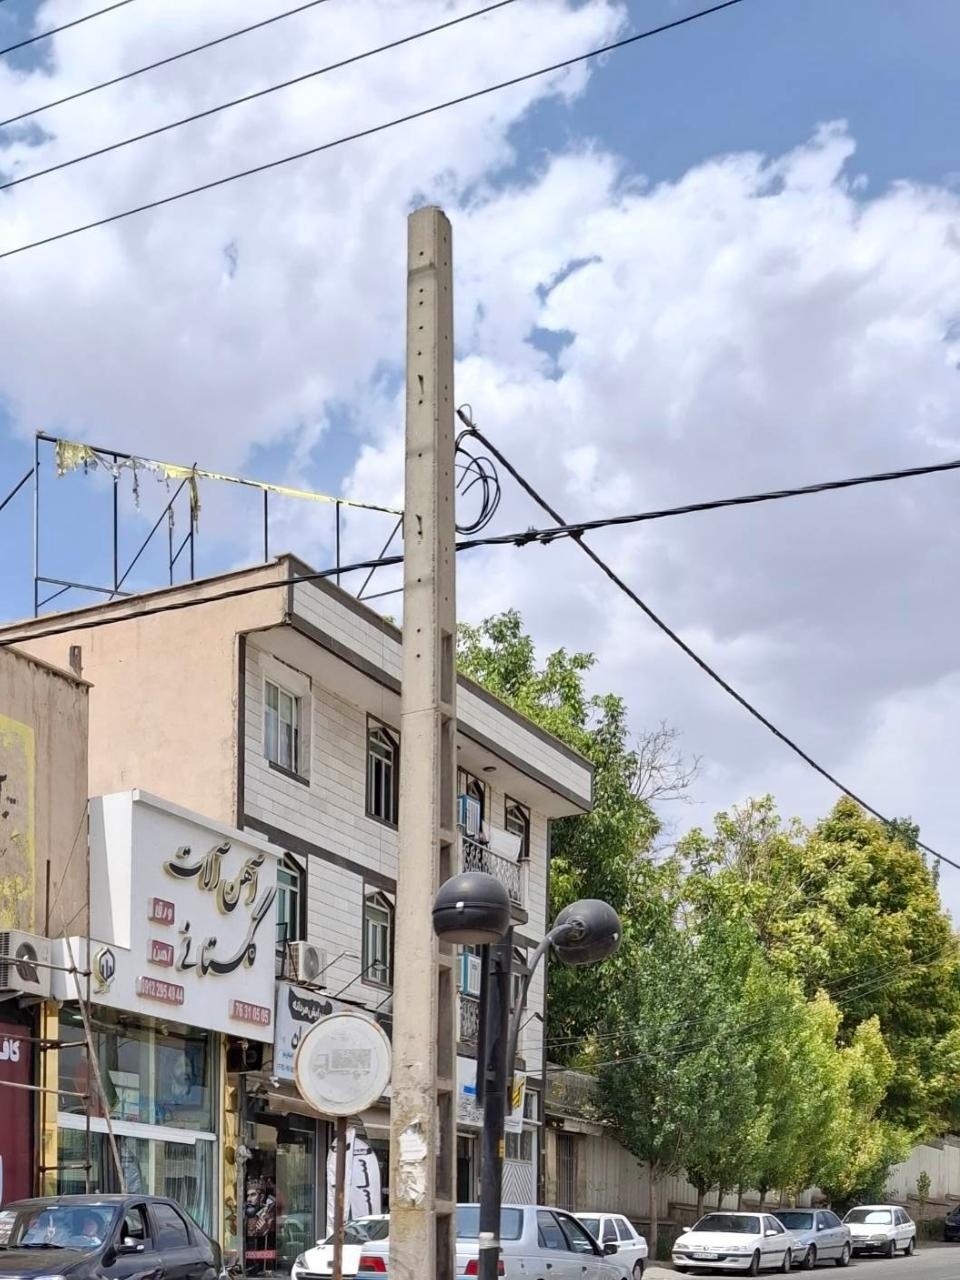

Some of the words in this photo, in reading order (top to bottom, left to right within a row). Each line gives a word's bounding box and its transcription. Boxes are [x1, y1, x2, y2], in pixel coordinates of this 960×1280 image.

[163, 841, 231, 891] آلات
[217, 853, 266, 914] آهن
[155, 902, 173, 921] ورق
[153, 945, 172, 962] آهن
